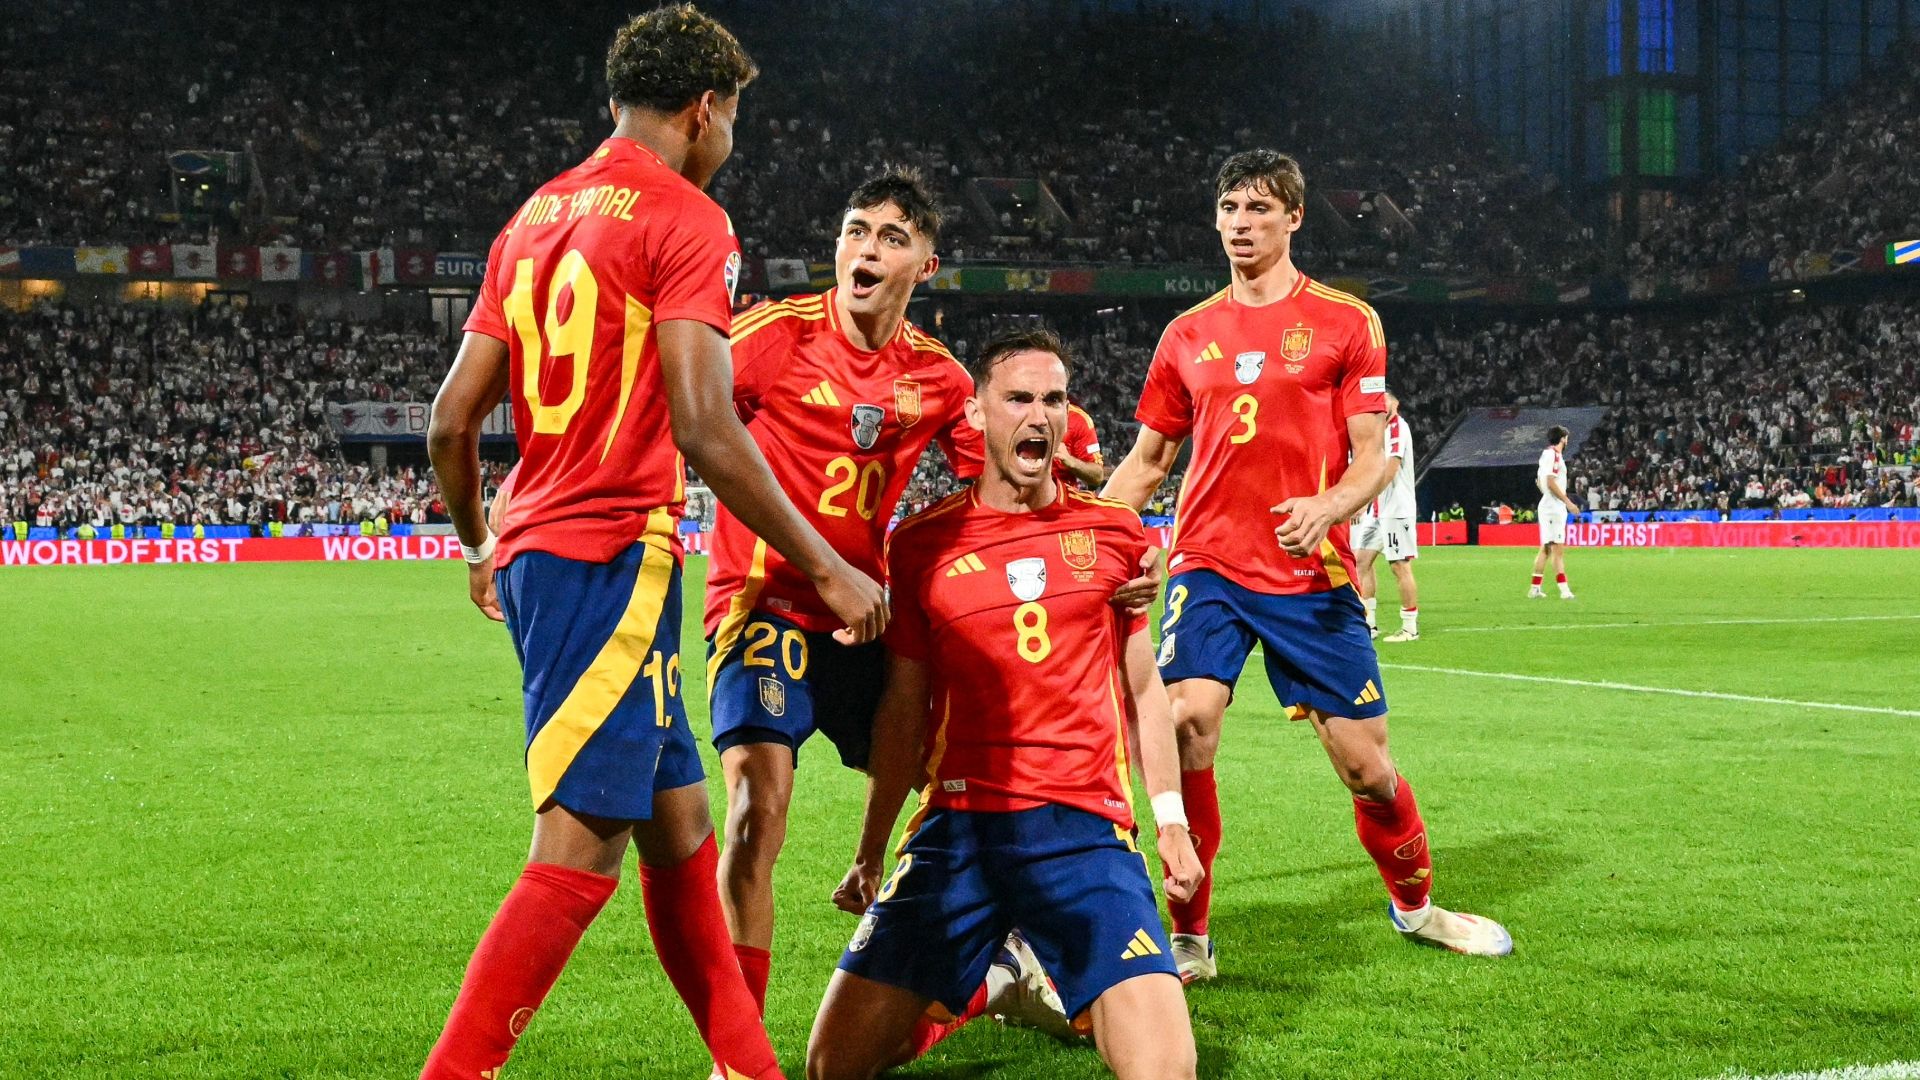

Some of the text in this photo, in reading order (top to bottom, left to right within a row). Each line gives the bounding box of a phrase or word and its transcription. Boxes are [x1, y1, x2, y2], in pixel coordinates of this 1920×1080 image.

[567, 184, 641, 222] YAMAL
[1165, 276, 1217, 293] KÖLN
[502, 248, 599, 434] 19
[1230, 393, 1259, 445] 3
[817, 455, 886, 520] 20
[1, 538, 243, 566] WORLDFIRST
[322, 536, 460, 561] WORLDF
[1388, 532, 1399, 547] 14
[1566, 523, 1660, 546] RLDFIRST
[1162, 584, 1188, 632] 3
[743, 621, 808, 680] 20
[1013, 602, 1052, 664] 8
[643, 650, 679, 728] 19
[877, 852, 913, 903] 8
